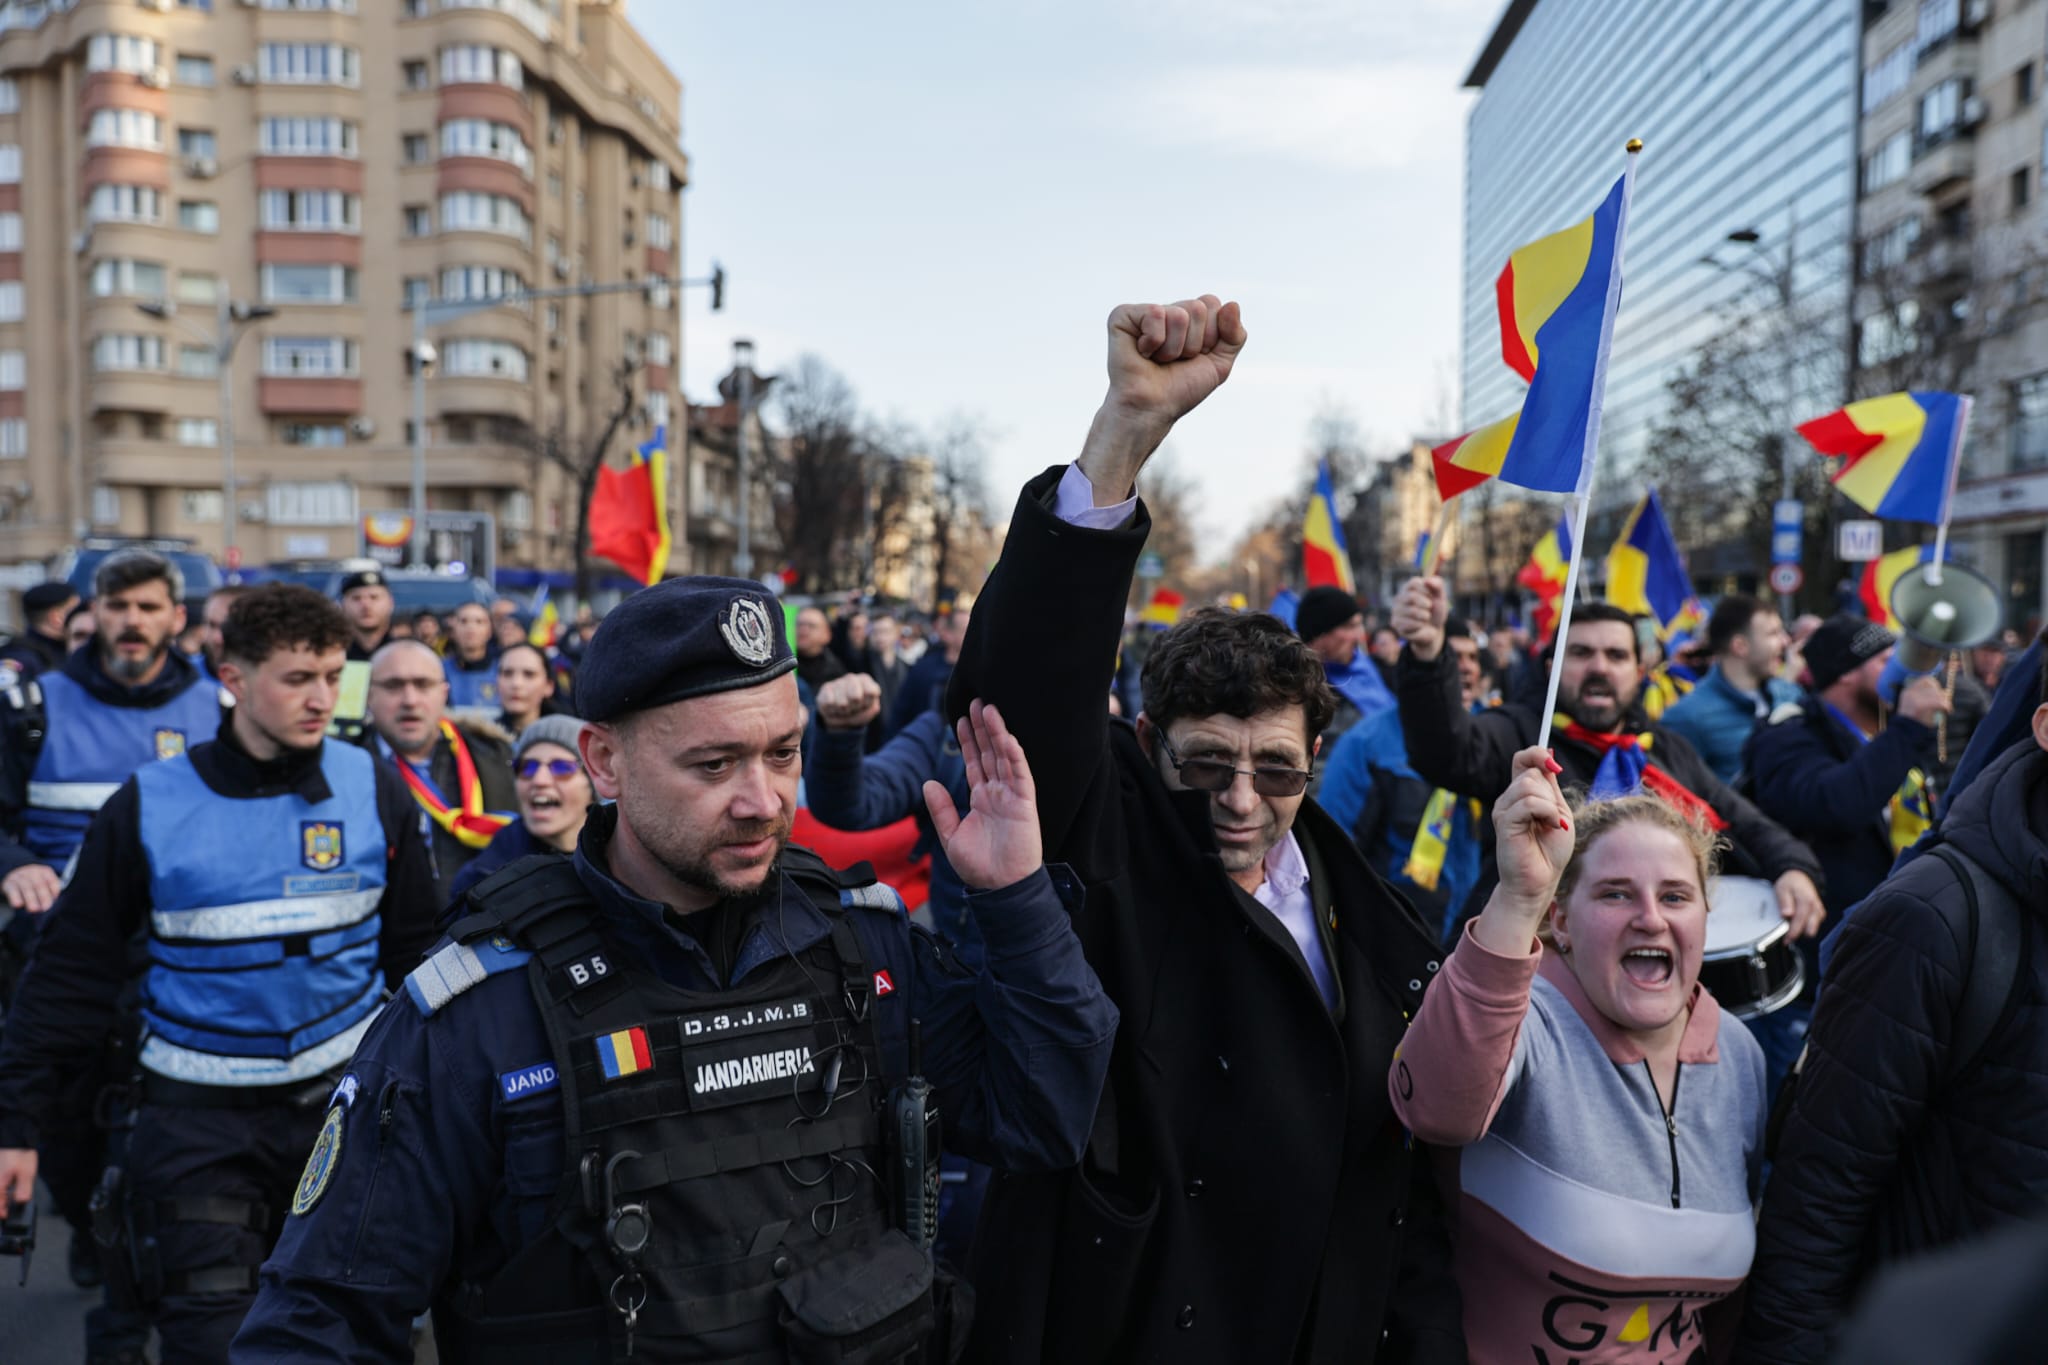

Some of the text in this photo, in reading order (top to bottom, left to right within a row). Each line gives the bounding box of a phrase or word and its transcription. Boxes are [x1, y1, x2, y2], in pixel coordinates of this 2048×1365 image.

[876, 974, 892, 995] A
[507, 1067, 559, 1094] JAND
[694, 1047, 815, 1094] JANDARMERIA
